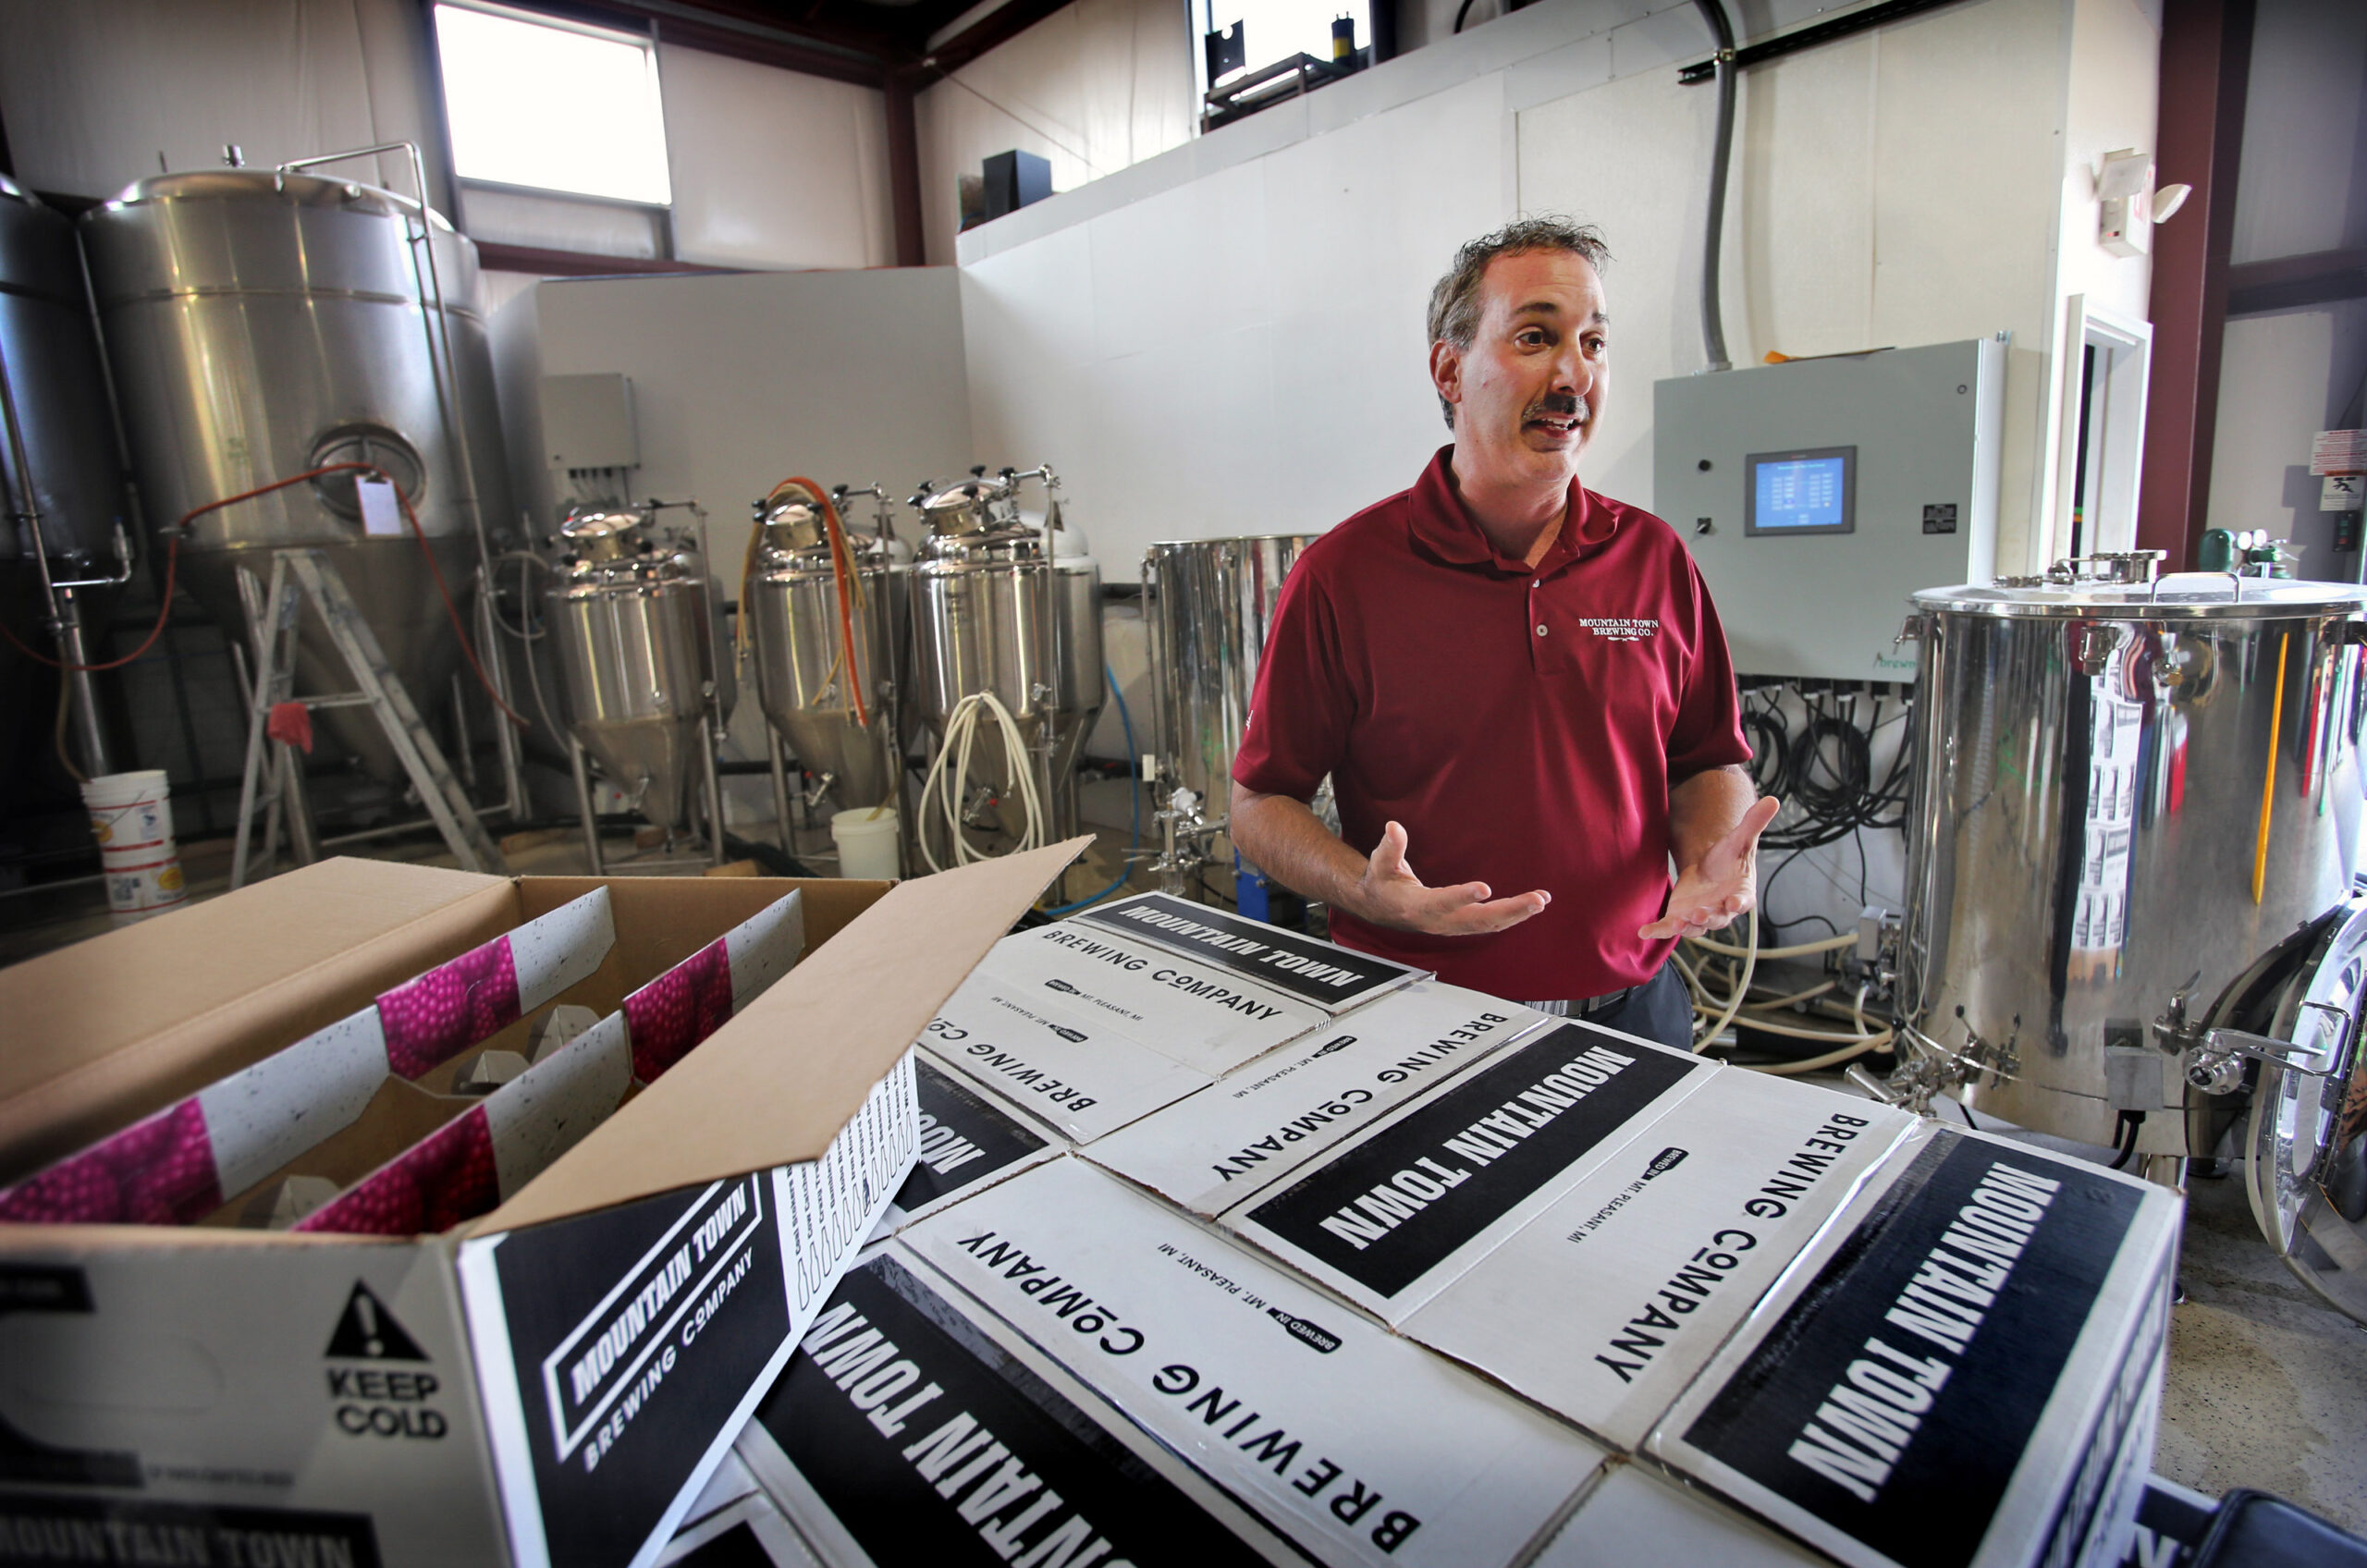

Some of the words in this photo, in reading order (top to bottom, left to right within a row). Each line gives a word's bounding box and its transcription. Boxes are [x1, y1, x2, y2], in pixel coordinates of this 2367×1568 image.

[1579, 619, 1630, 627] MOUNTAIN
[1632, 619, 1659, 628] TOWN
[1592, 628, 1637, 636] BREWING
[1042, 930, 1148, 972] BREWING
[1118, 905, 1260, 957] MOUNTAIN
[1260, 949, 1364, 987] TOWN
[1377, 1012, 1508, 1084] BREWING
[967, 1044, 1098, 1112] BREWING
[1442, 1046, 1637, 1168] MOUNTAIN
[1654, 1149, 1683, 1170] BREWED
[1745, 1113, 1870, 1219] BREWING
[1318, 1156, 1472, 1251] TOWN
[1158, 1243, 1178, 1256] MI
[1566, 1231, 1587, 1243] MI
[1883, 1161, 2061, 1355] MOUNTAIN
[570, 1243, 692, 1406] MOUNTAIN
[693, 1182, 746, 1262] TOWN
[1177, 1253, 1242, 1294] PLEASANT,
[1242, 1292, 1266, 1309] MT.
[1275, 1313, 1292, 1325] IN
[1289, 1320, 1336, 1351] BREWED
[326, 1368, 439, 1401] KEEP
[801, 1301, 944, 1439] TOWN
[337, 1404, 448, 1439] COLD
[583, 1345, 676, 1474] BREWING
[1787, 1336, 1953, 1504] TOWN
[1152, 1365, 1422, 1554] BREWING
[218, 1528, 354, 1568] TOWN
